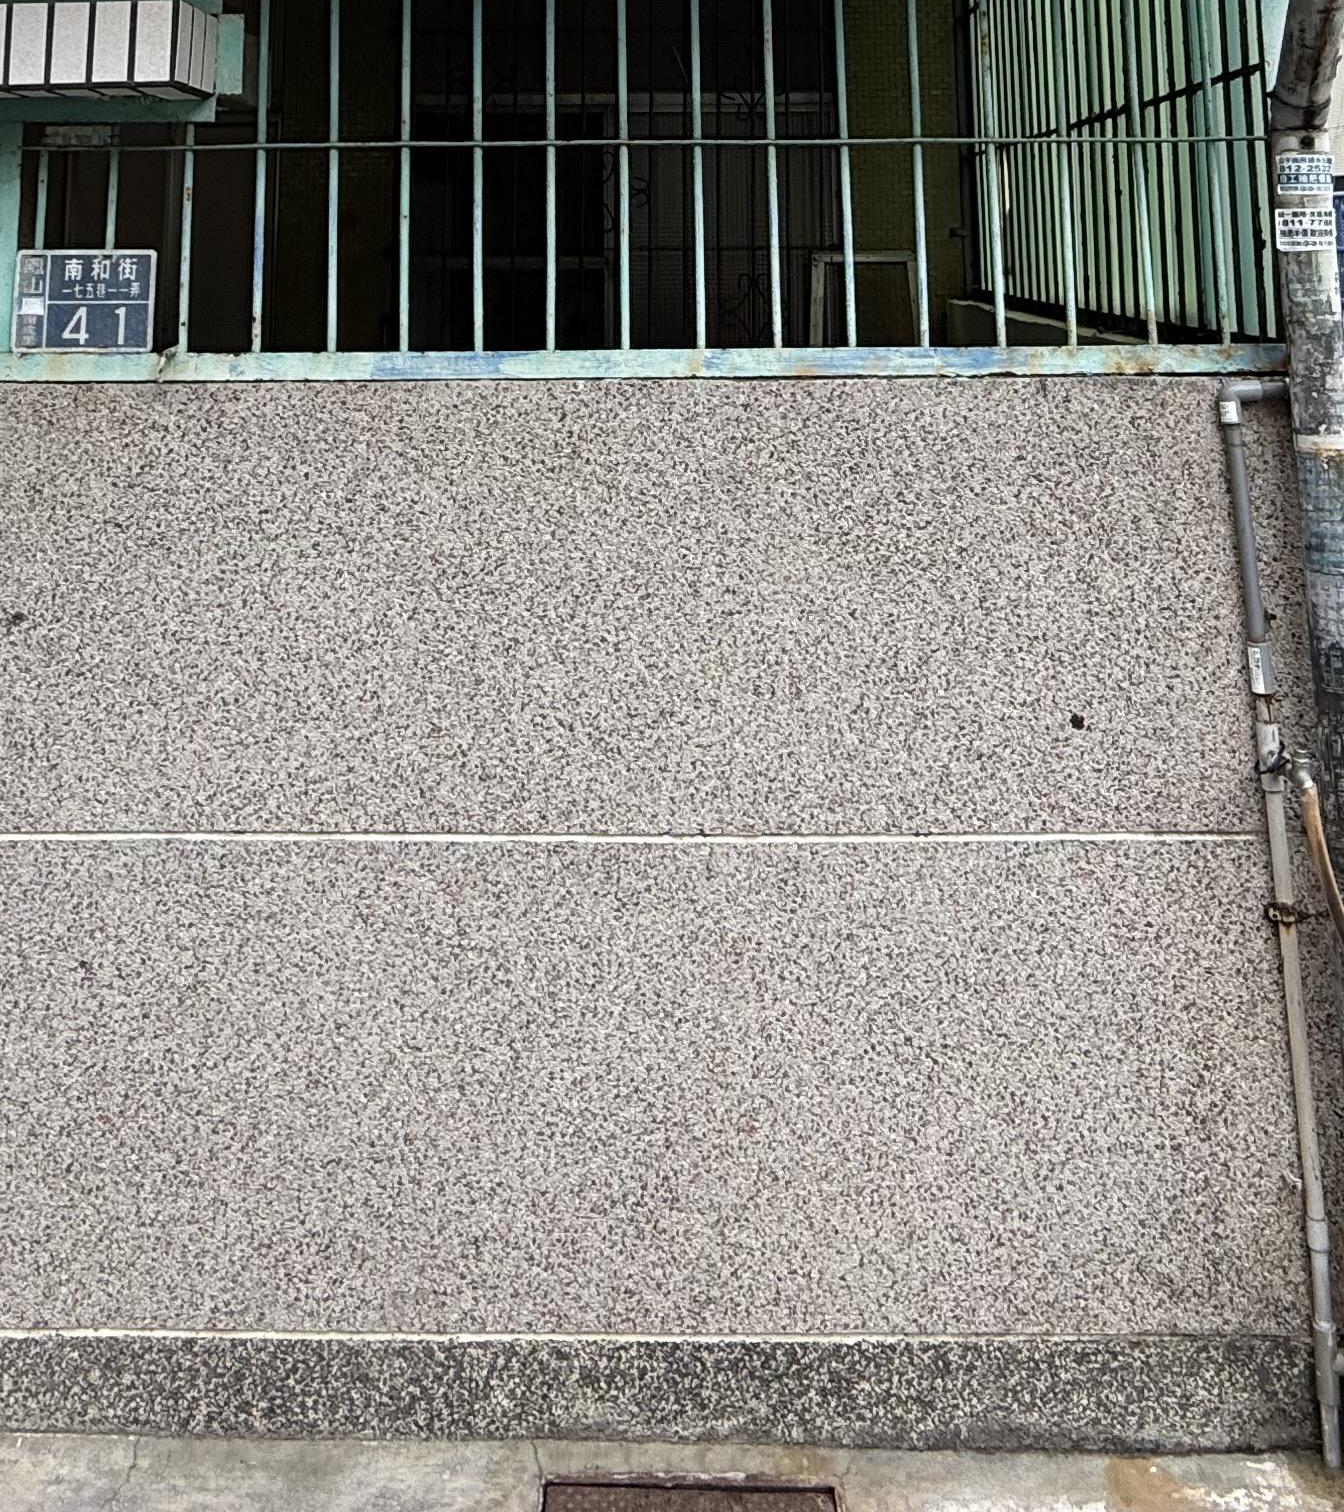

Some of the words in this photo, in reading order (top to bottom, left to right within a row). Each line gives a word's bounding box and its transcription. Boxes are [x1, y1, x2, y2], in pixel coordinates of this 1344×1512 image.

[64, 258, 138, 281] 南和街
[61, 282, 140, 299] 一七五巷一一弄
[61, 306, 127, 345] 41
